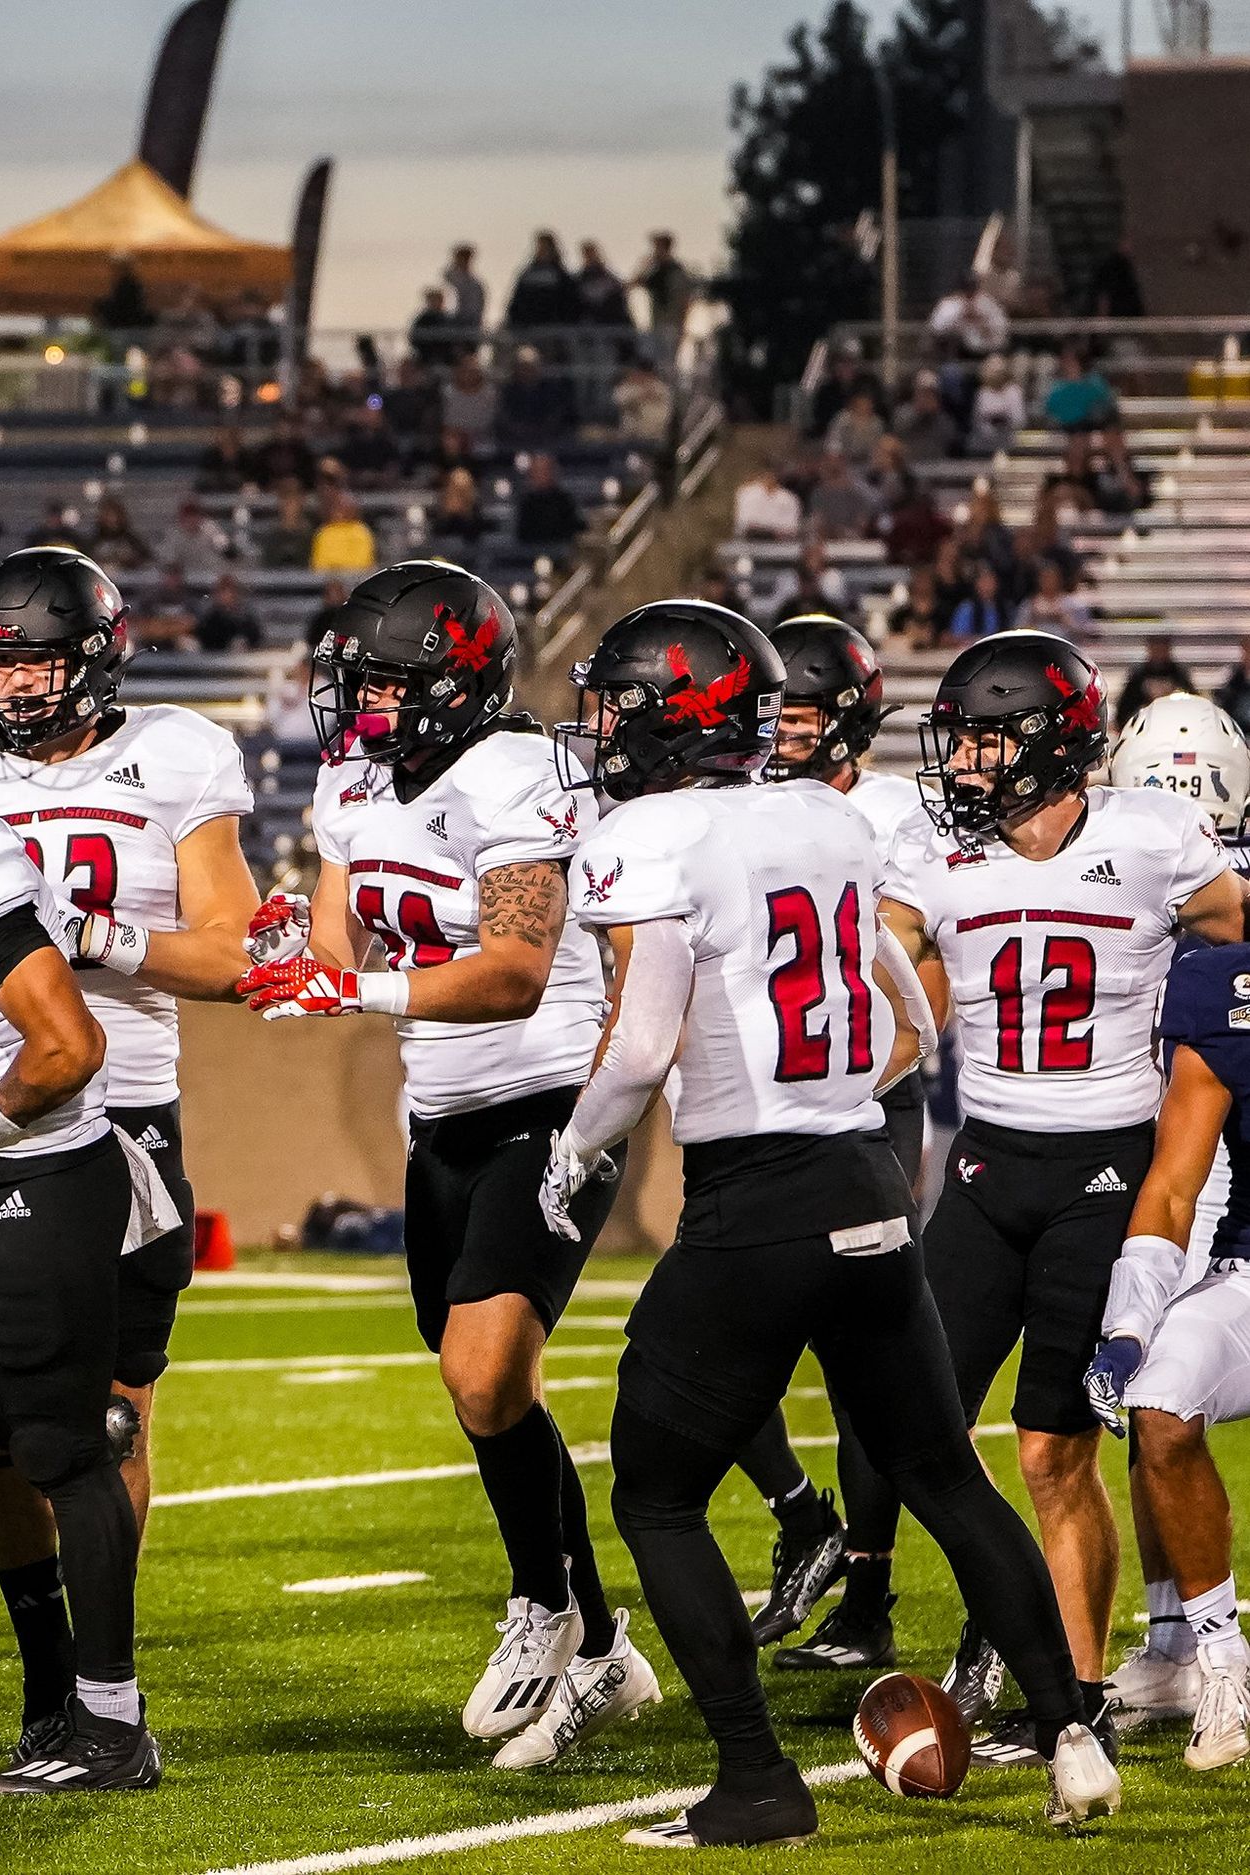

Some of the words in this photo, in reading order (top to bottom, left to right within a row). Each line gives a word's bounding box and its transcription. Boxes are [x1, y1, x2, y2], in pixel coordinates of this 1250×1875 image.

[104, 773, 146, 790] adidas
[38, 806, 149, 831] WASHINGTON
[960, 842, 983, 859] SKY
[1080, 872, 1122, 887] adidas
[766, 880, 874, 1083] 21
[989, 935, 1098, 1073] 12
[138, 1138, 169, 1151] didas
[1084, 1181, 1128, 1194] adidas
